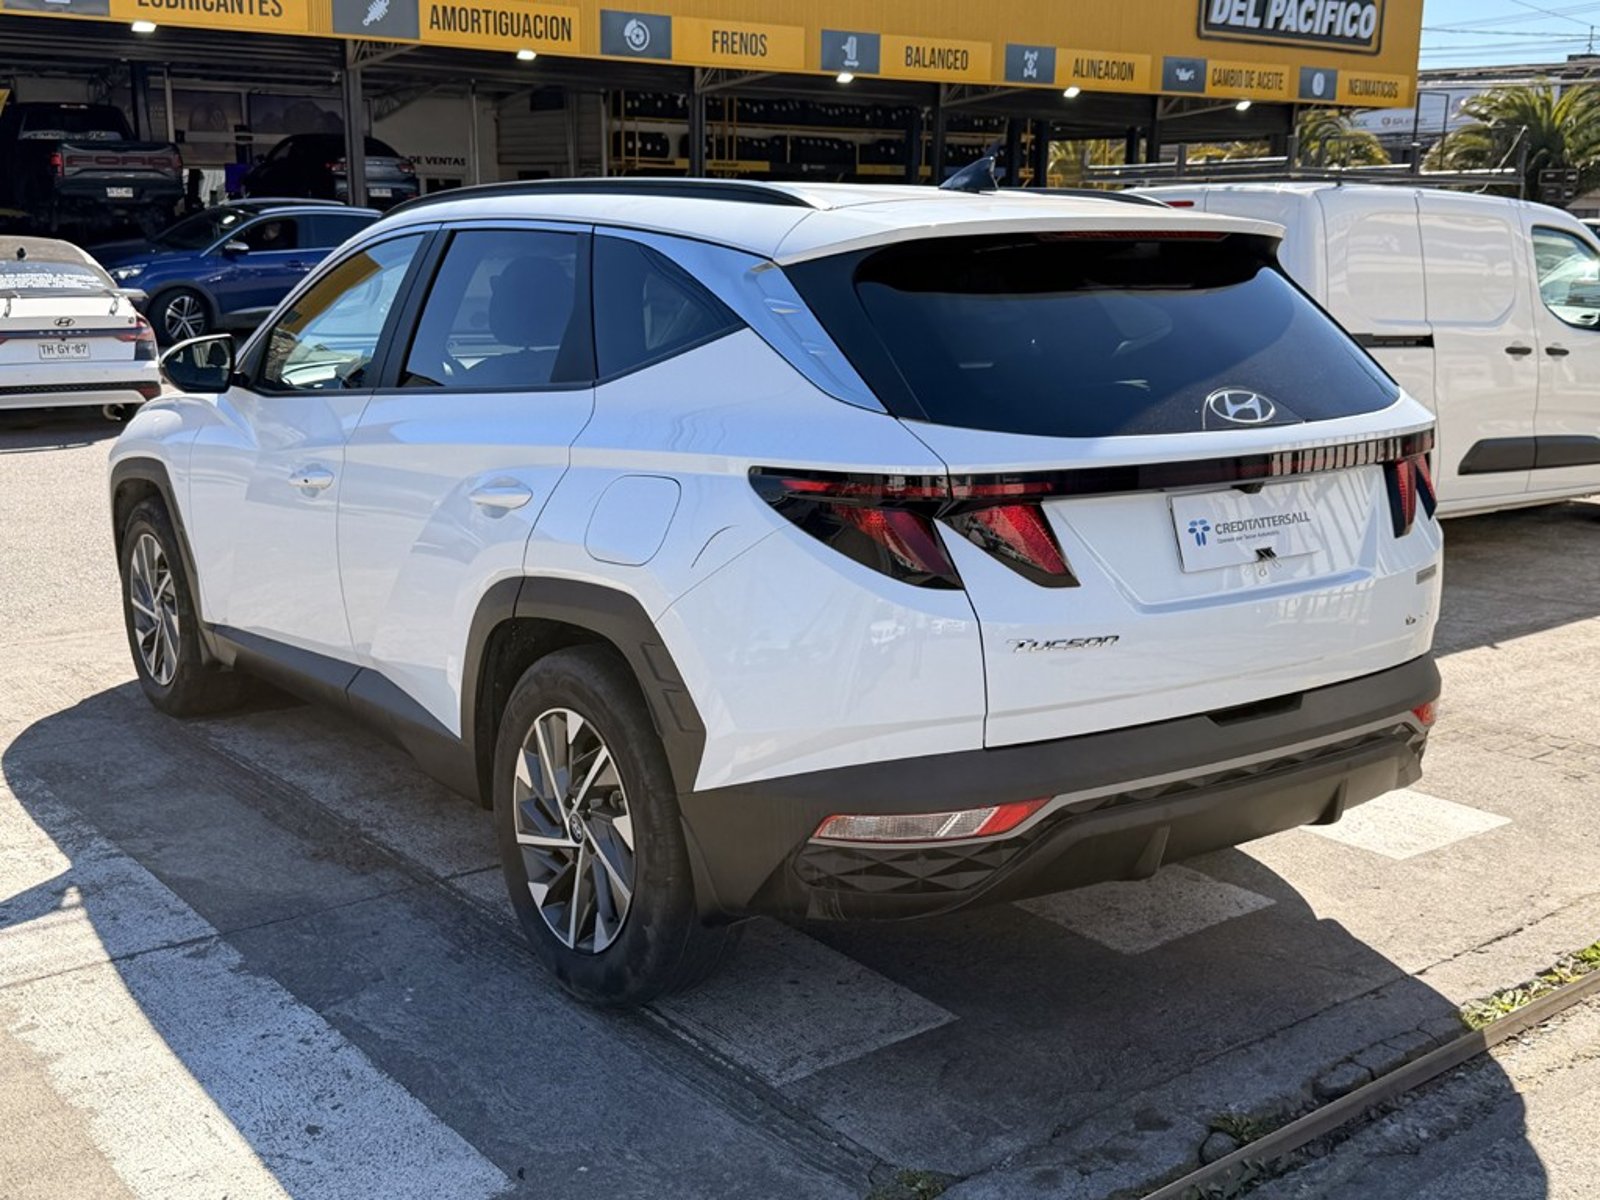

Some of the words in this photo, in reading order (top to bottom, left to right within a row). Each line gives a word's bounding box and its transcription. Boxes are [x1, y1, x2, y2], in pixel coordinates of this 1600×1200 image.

[429, 4, 573, 42] AMORTIGUACION
[1209, 0, 1262, 27] DEL
[1266, 0, 1377, 39] PACIFICO
[711, 29, 768, 57] FRENOS
[905, 45, 969, 71] BALANCEO
[1072, 57, 1136, 82] ALINEACION
[1212, 67, 1243, 89] CAMBIO
[1244, 70, 1256, 89] DE
[1257, 71, 1285, 91] ACEITE
[1348, 78, 1399, 99] NEUMATICOS
[65, 154, 173, 169] FORD
[408, 155, 422, 165] DE
[425, 155, 466, 166] VENTAS
[1215, 511, 1311, 536] CREDITATTERSALL
